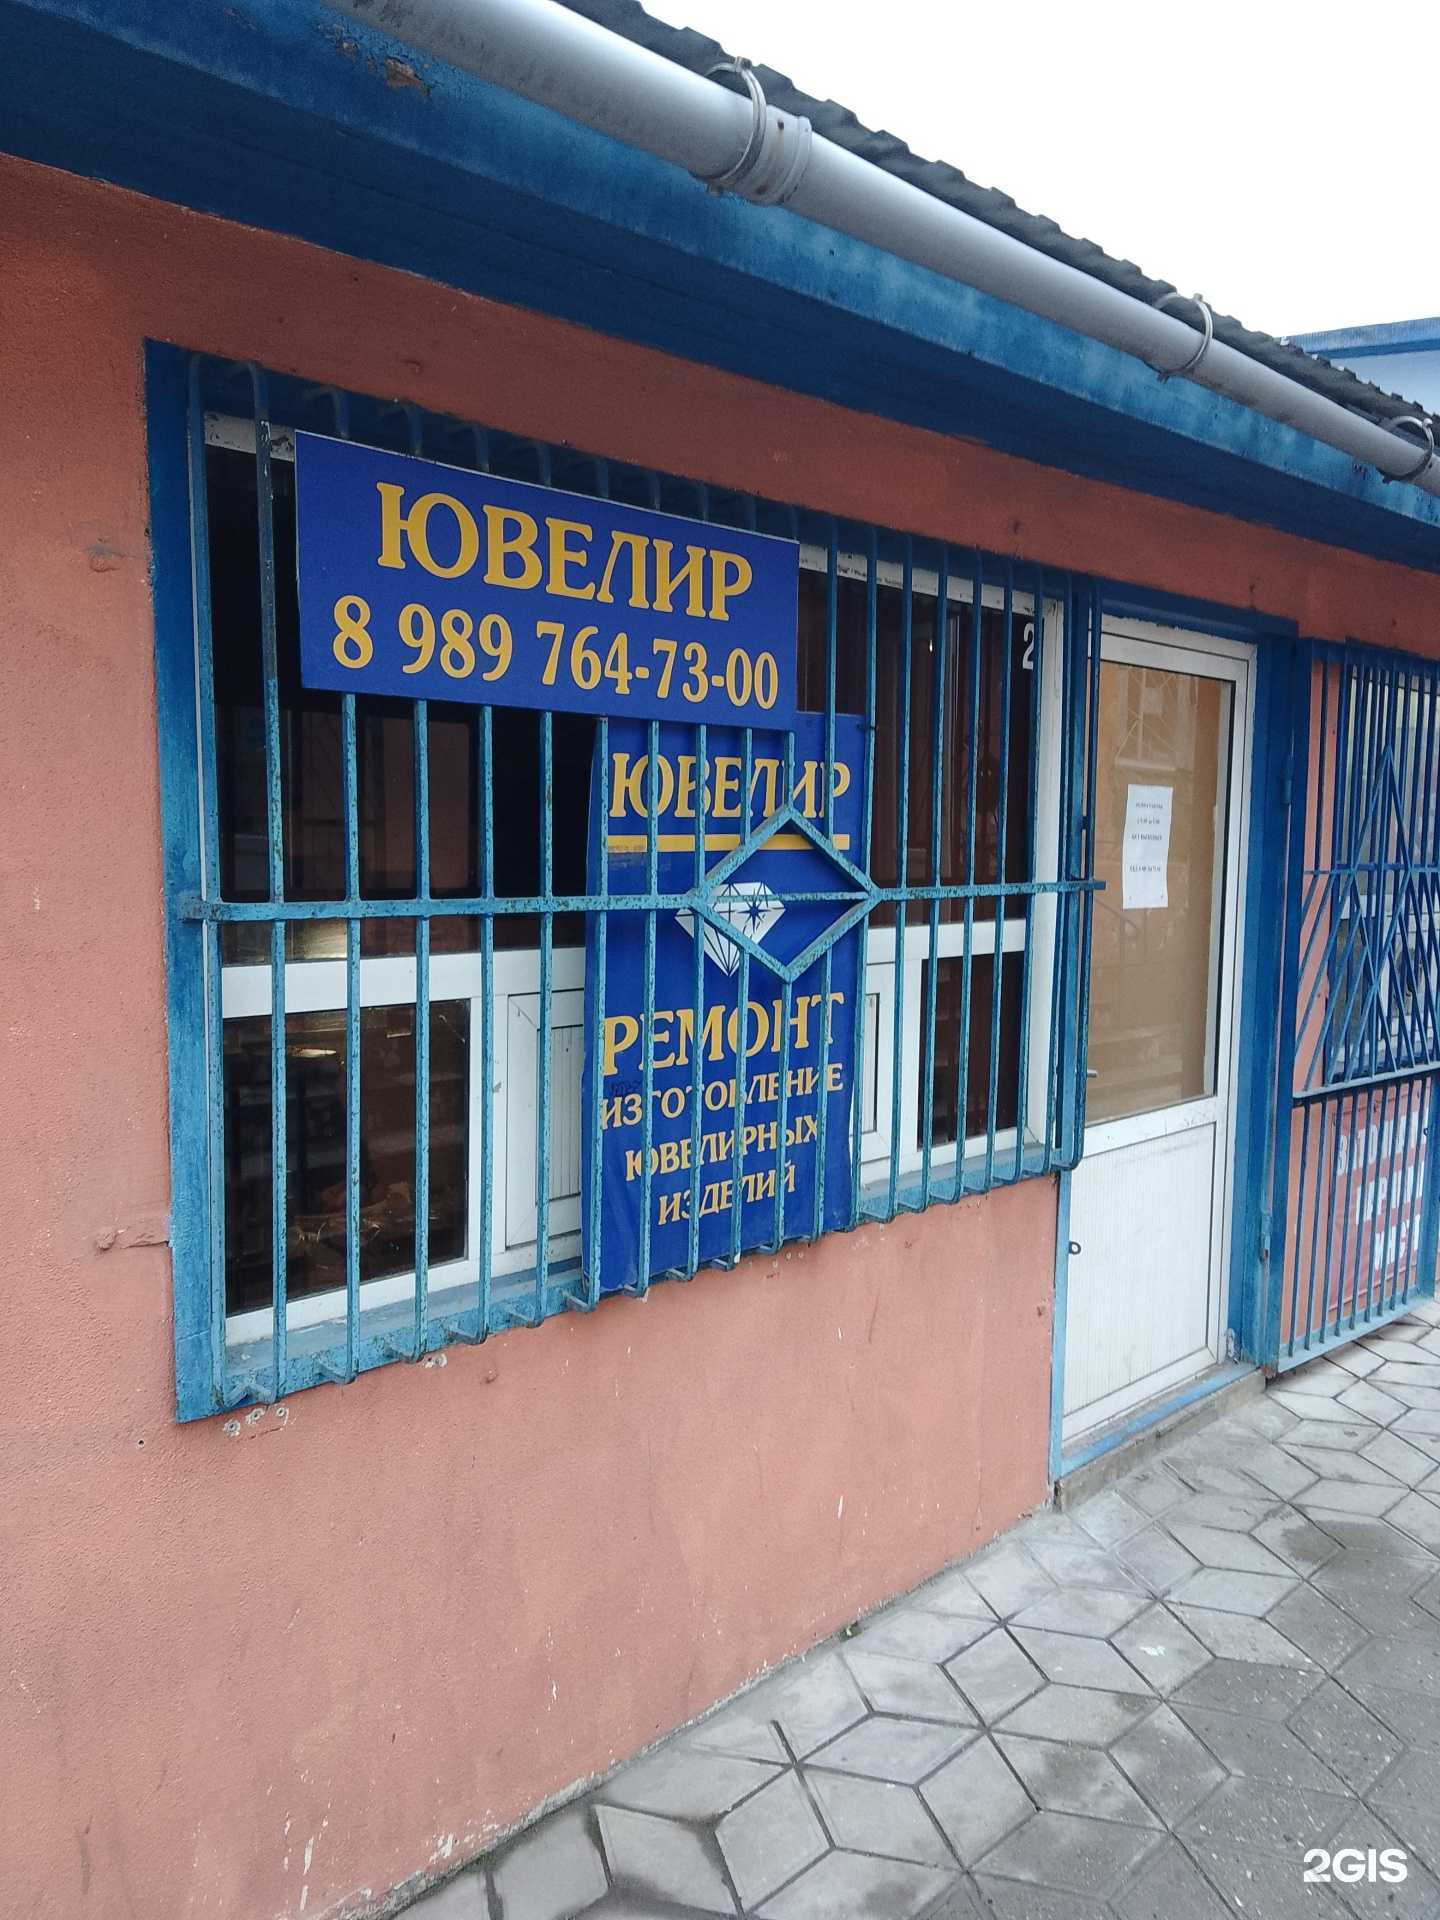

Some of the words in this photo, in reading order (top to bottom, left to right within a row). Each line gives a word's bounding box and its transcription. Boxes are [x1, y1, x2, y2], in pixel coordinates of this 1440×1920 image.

[376, 481, 753, 621] ЮВЕЛИР
[332, 594, 374, 669] 8
[398, 602, 513, 682] 989
[536, 620, 779, 710] 764-73-00
[609, 752, 850, 818] ЮВЕЛИР
[601, 992, 845, 1076] РЕМОНТ
[600, 1063, 844, 1130] ИЗООЛЕНИЕ
